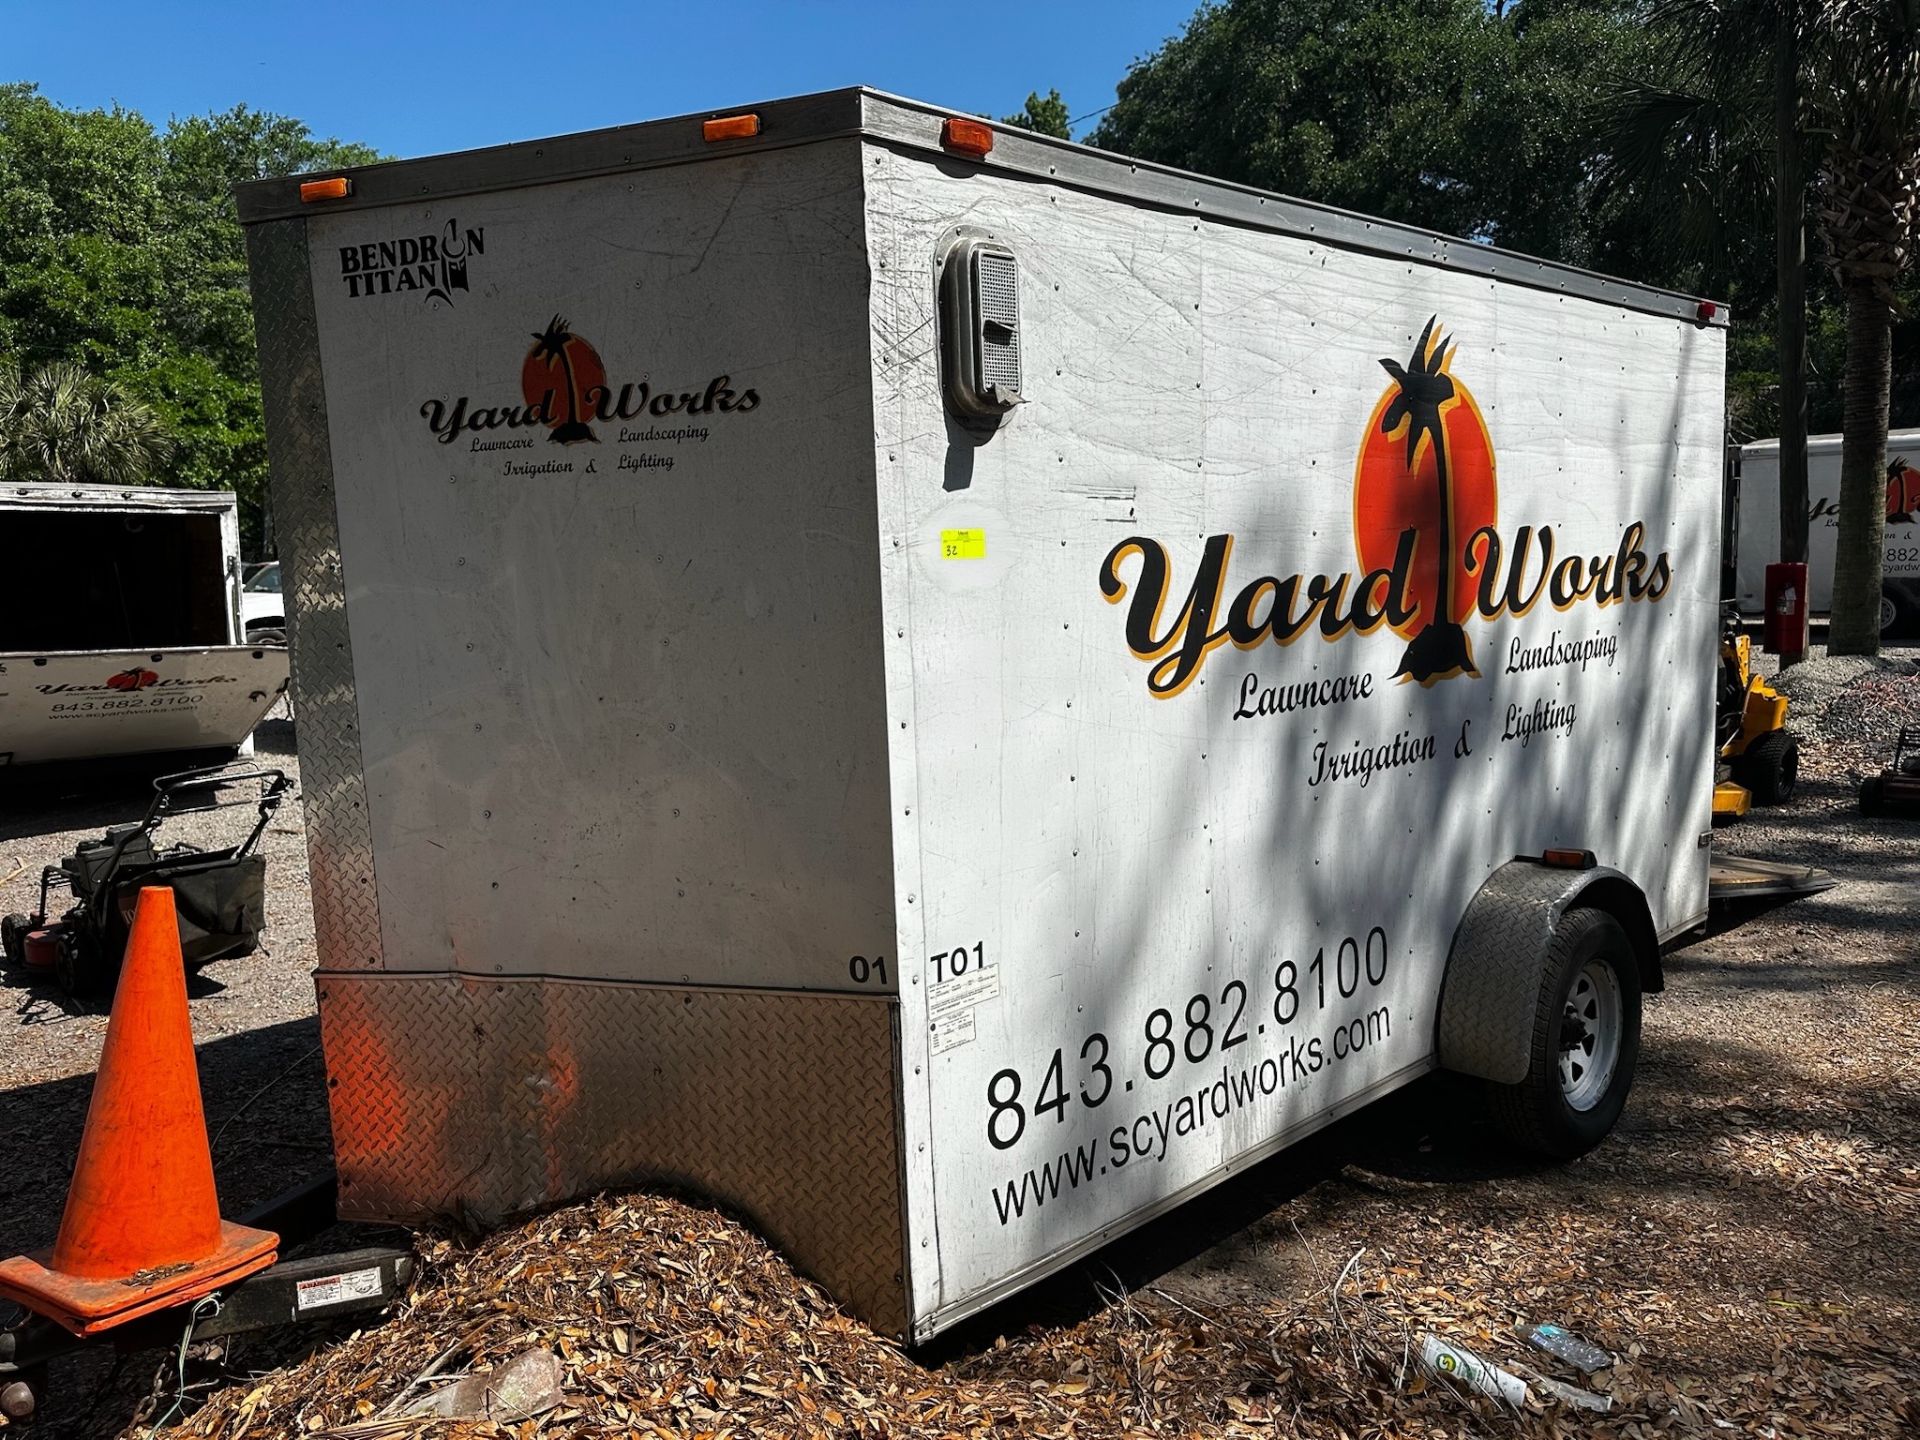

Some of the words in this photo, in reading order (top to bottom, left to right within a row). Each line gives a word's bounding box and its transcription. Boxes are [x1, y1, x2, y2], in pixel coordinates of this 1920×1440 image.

[338, 218, 485, 274] BENDRON
[343, 264, 436, 298] TITAN
[420, 389, 556, 445] Yard
[584, 374, 762, 423] Works
[469, 437, 535, 453] Lawncare
[617, 424, 710, 445] Landscaping
[503, 459, 574, 478] Irrigation
[585, 459, 598, 473] &
[617, 453, 676, 471] Lighting
[1099, 528, 1420, 700] Yard
[1464, 521, 1673, 621] Works
[51, 694, 204, 713] 843.882.8100
[1232, 671, 1374, 720] Lawncare
[1505, 629, 1619, 675] Landscaping
[1308, 731, 1437, 788] Irrigation
[1453, 718, 1473, 760] &
[1500, 698, 1577, 742] Lighting
[986, 926, 1389, 1150] 843.882.8100
[991, 1005, 1392, 1226] www.scyardworks.com
